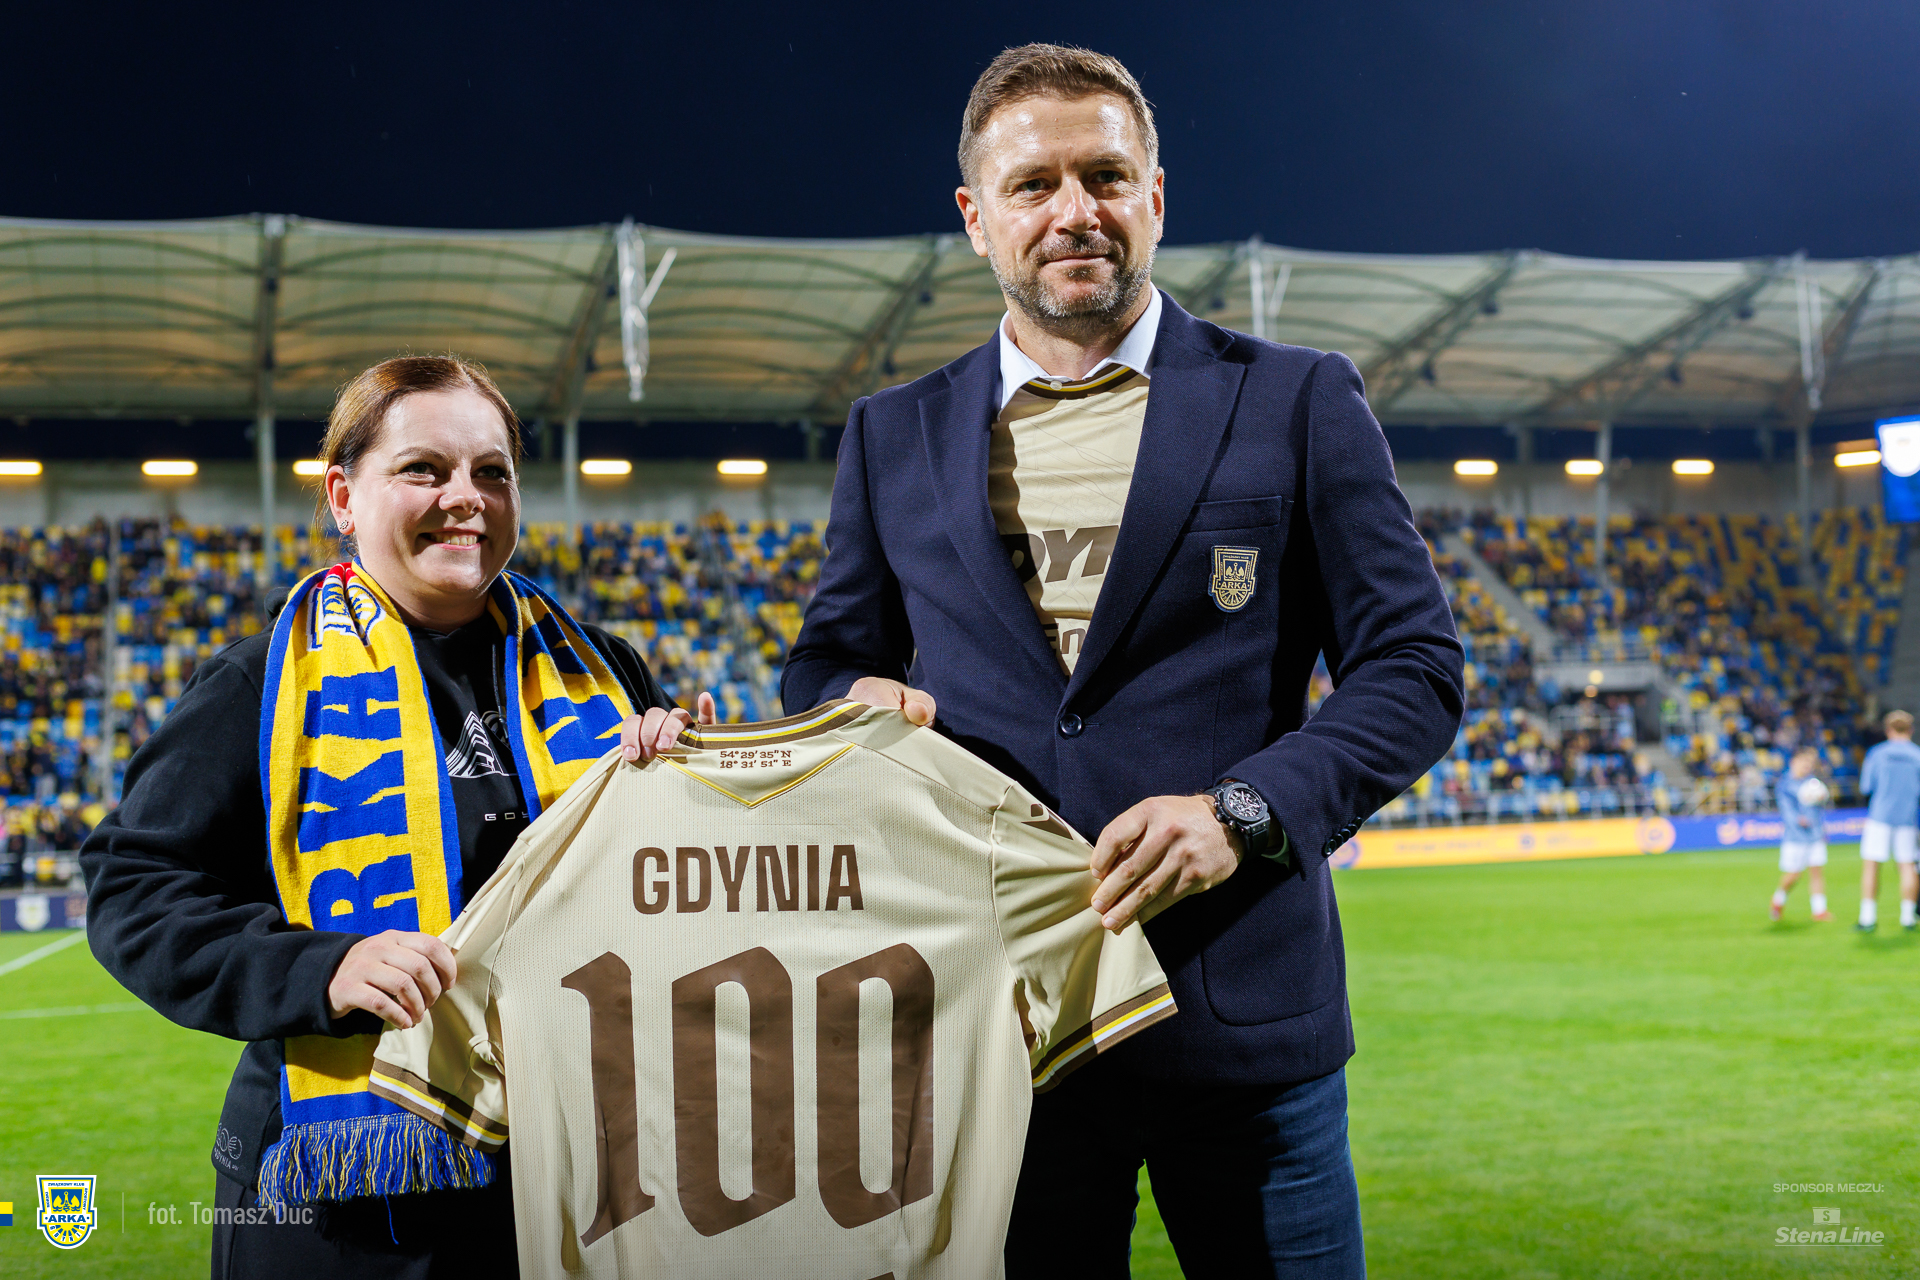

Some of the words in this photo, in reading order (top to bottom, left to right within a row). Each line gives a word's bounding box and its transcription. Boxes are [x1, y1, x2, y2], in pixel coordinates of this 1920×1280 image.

[1221, 581, 1248, 590] ARKA
[632, 844, 864, 915] GDYNIA
[561, 942, 935, 1249] 100
